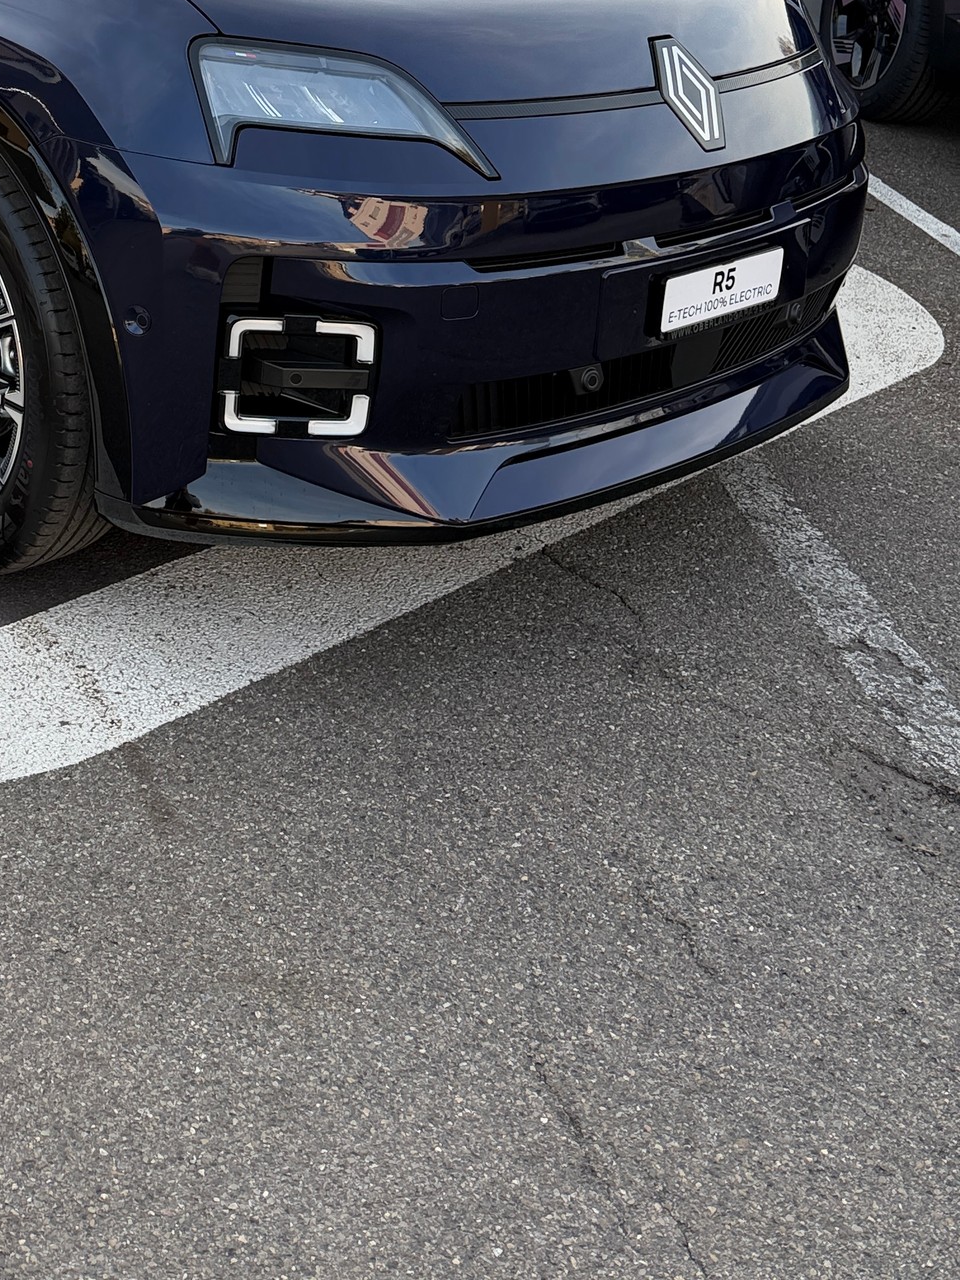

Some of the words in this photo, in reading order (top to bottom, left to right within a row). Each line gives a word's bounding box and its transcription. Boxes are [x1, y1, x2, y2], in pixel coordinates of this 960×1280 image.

[712, 267, 737, 295] R5
[668, 303, 702, 324] E-TECH
[704, 296, 728, 313] 100%
[729, 283, 773, 306] ELECTRIC
